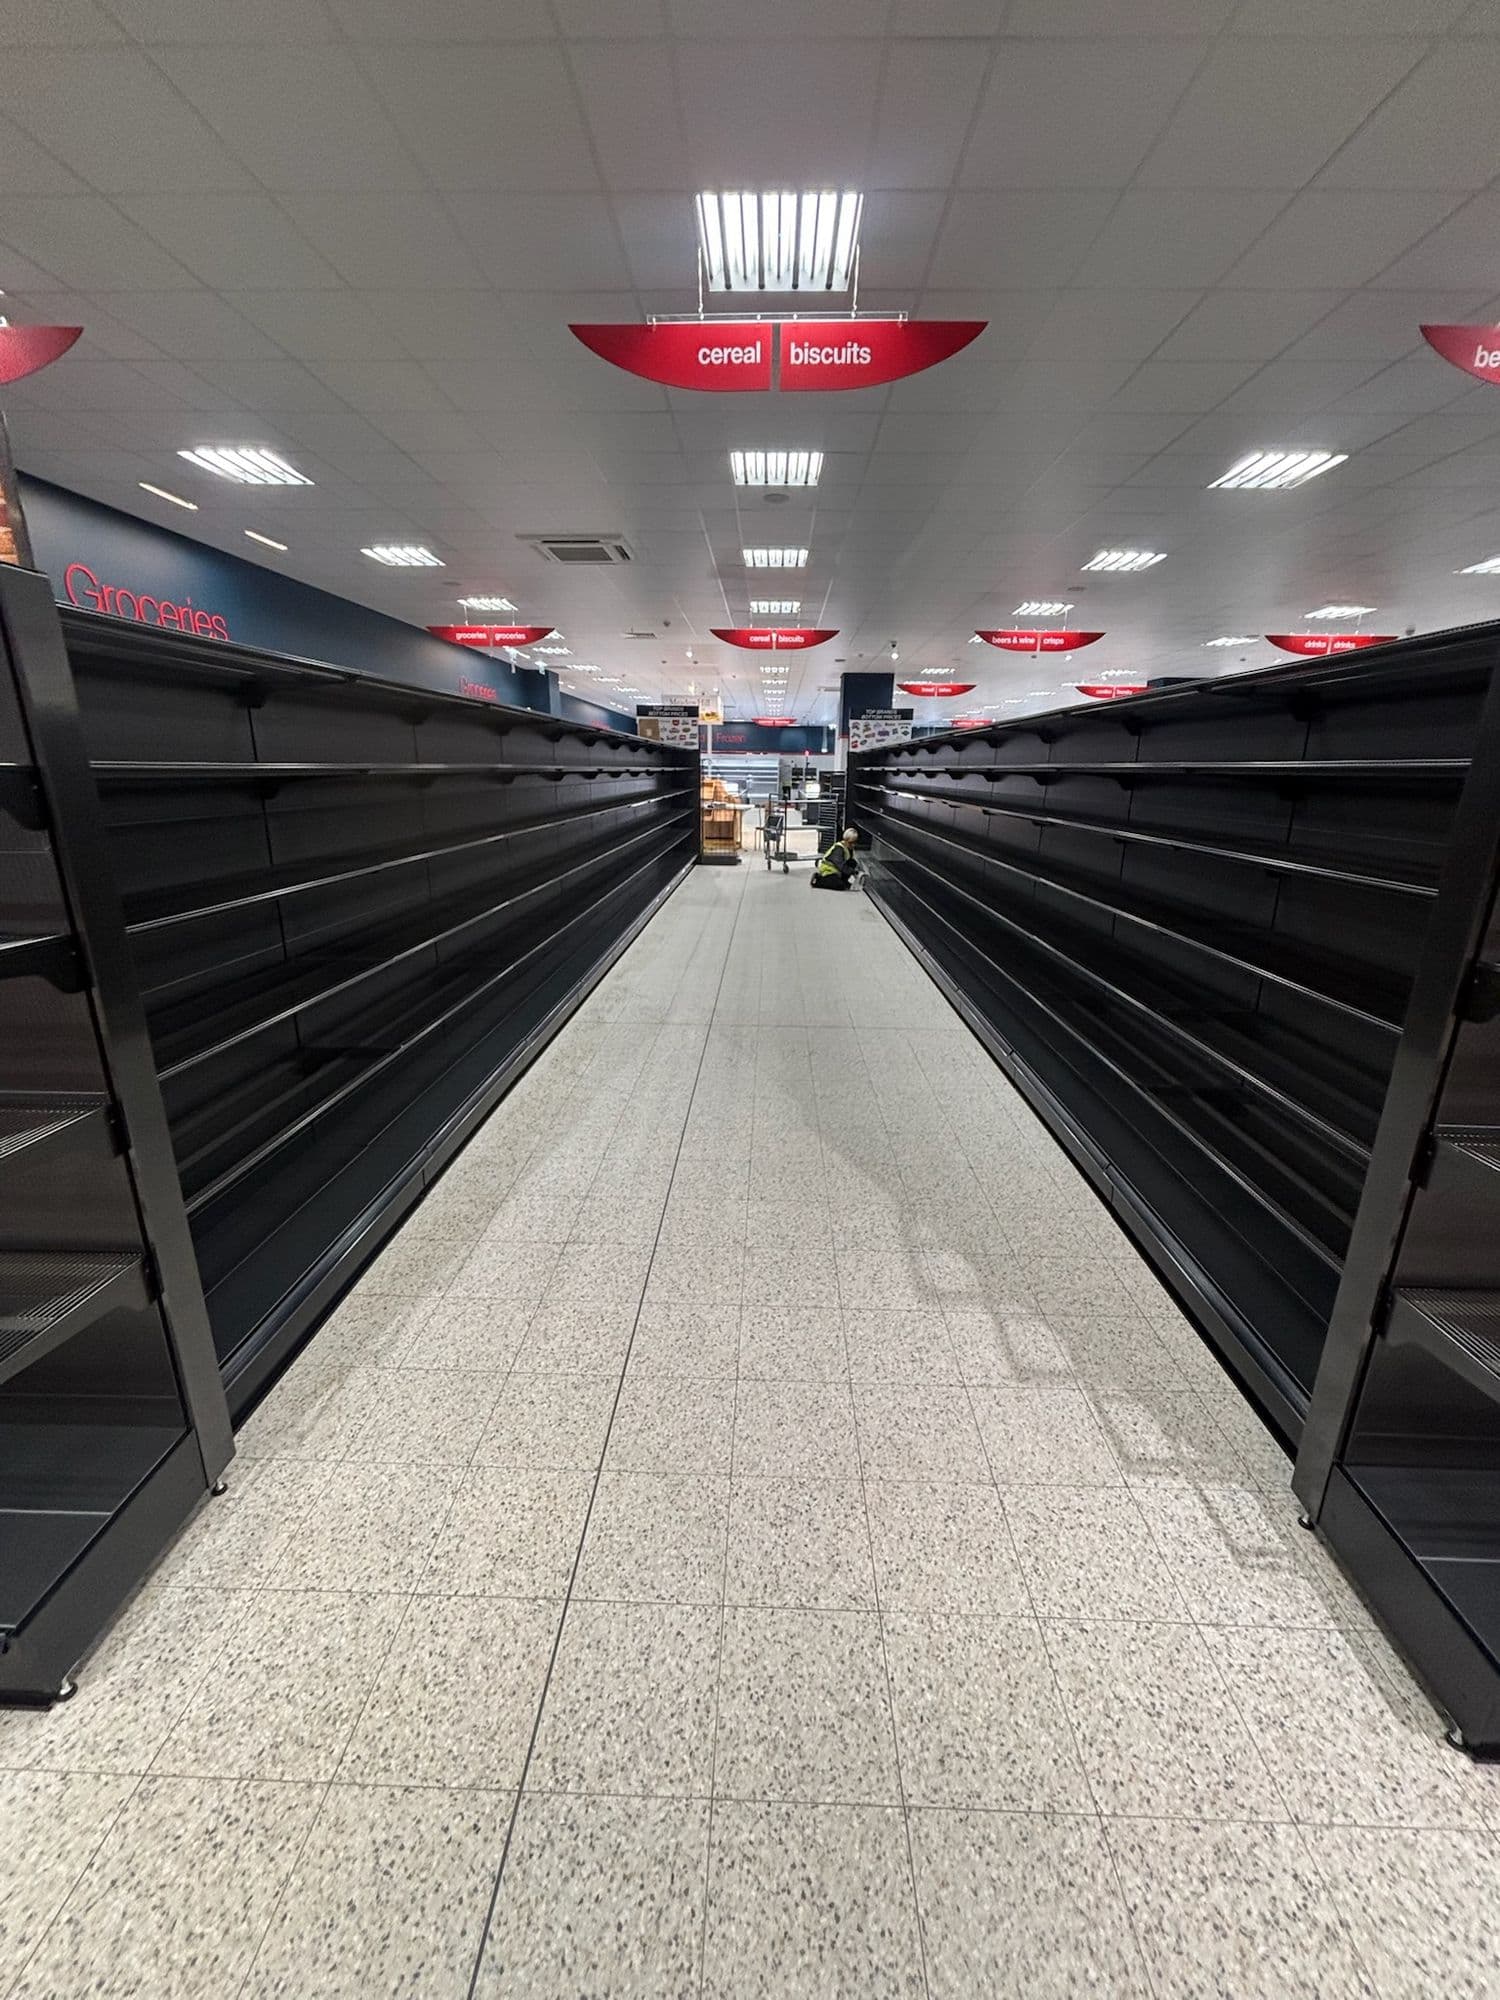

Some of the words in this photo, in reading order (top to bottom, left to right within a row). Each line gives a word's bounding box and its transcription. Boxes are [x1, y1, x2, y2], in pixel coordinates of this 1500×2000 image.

[698, 341, 761, 365] cereal
[789, 341, 872, 366] biscuits
[64, 562, 232, 642] Groceries
[455, 631, 487, 641] groceries
[494, 631, 527, 641] groceries
[749, 634, 771, 642] cereal
[778, 634, 805, 643] biscuits
[992, 635, 1011, 644] beers
[1019, 636, 1036, 644] wine
[1043, 636, 1065, 645] crisps
[1304, 641, 1327, 649] drinks
[1333, 641, 1357, 649] drinks
